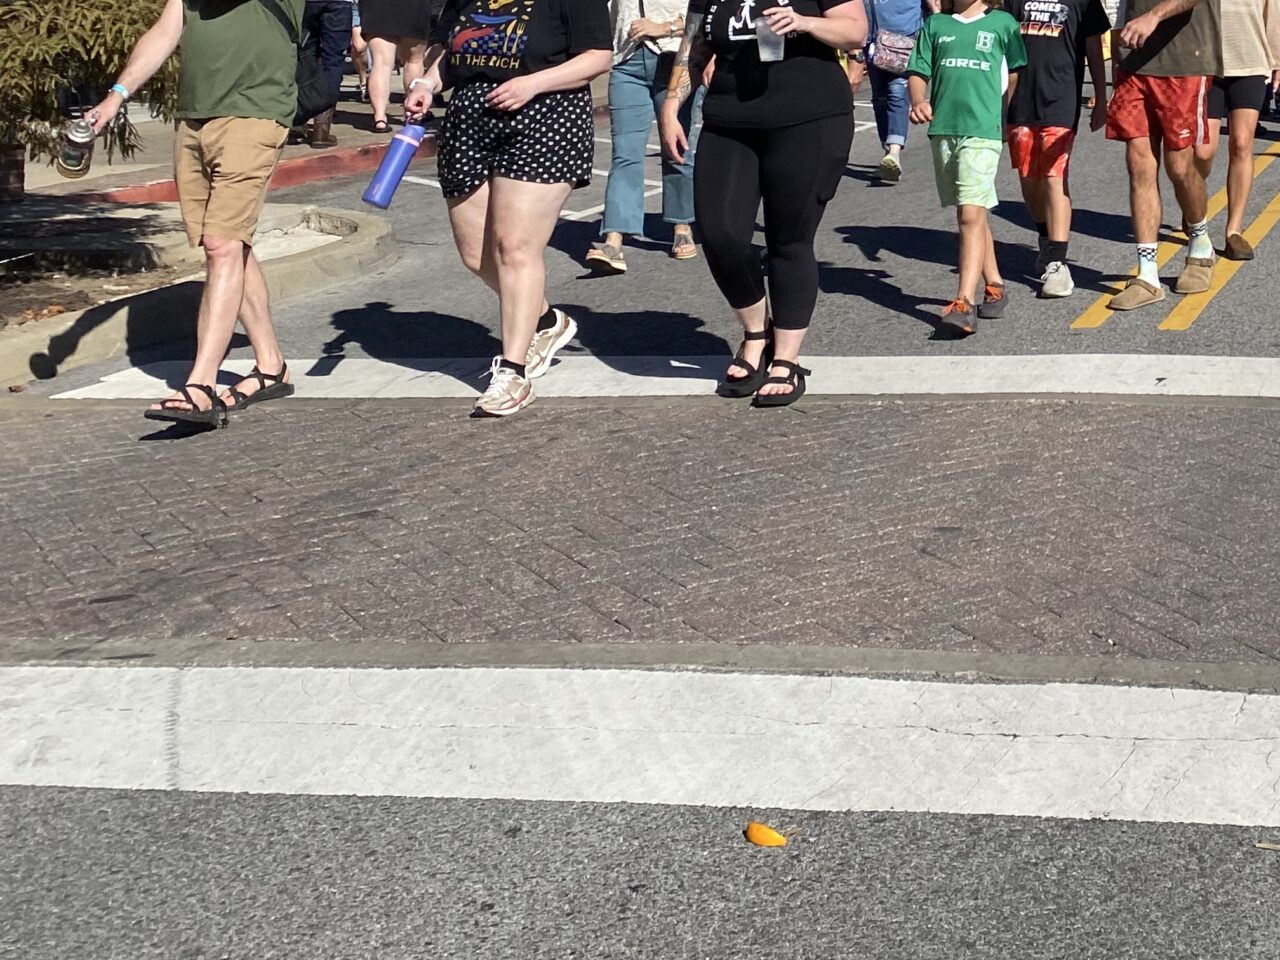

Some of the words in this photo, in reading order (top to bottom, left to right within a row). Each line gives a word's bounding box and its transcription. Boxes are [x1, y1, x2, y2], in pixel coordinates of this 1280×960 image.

[1024, 1, 1062, 12] COMES
[1030, 11, 1051, 22] THE
[465, 54, 487, 67] THE
